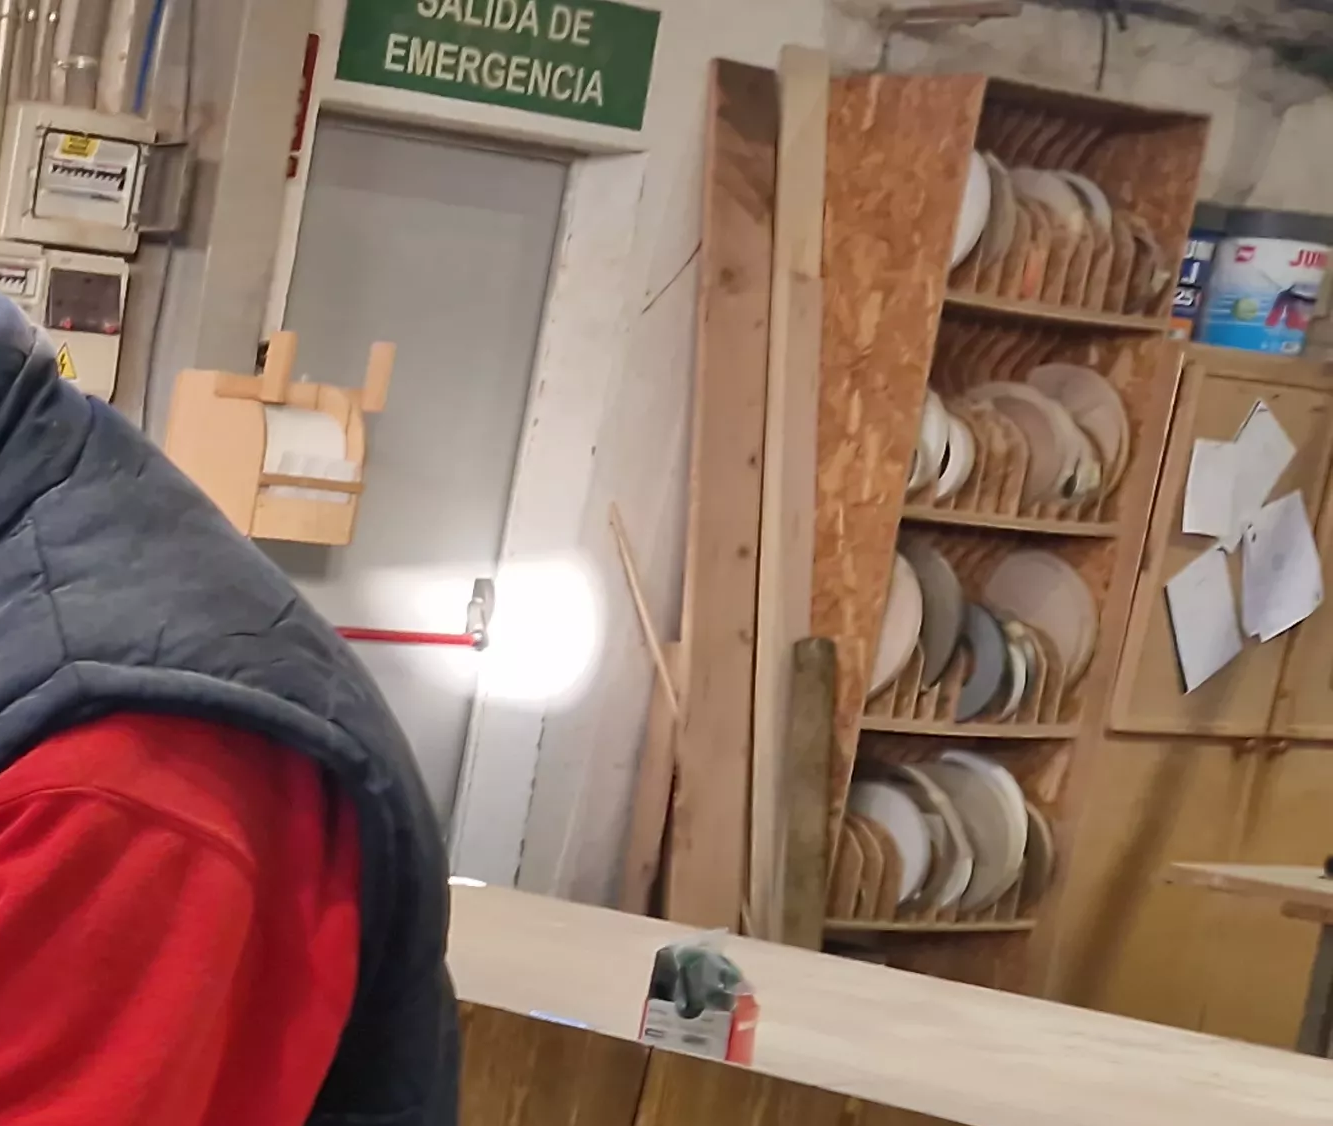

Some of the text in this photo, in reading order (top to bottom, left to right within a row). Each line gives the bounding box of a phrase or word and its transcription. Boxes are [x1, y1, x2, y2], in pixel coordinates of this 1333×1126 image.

[417, 0, 595, 45] SALIDA DE
[384, 33, 604, 107] EMERGENCIA
